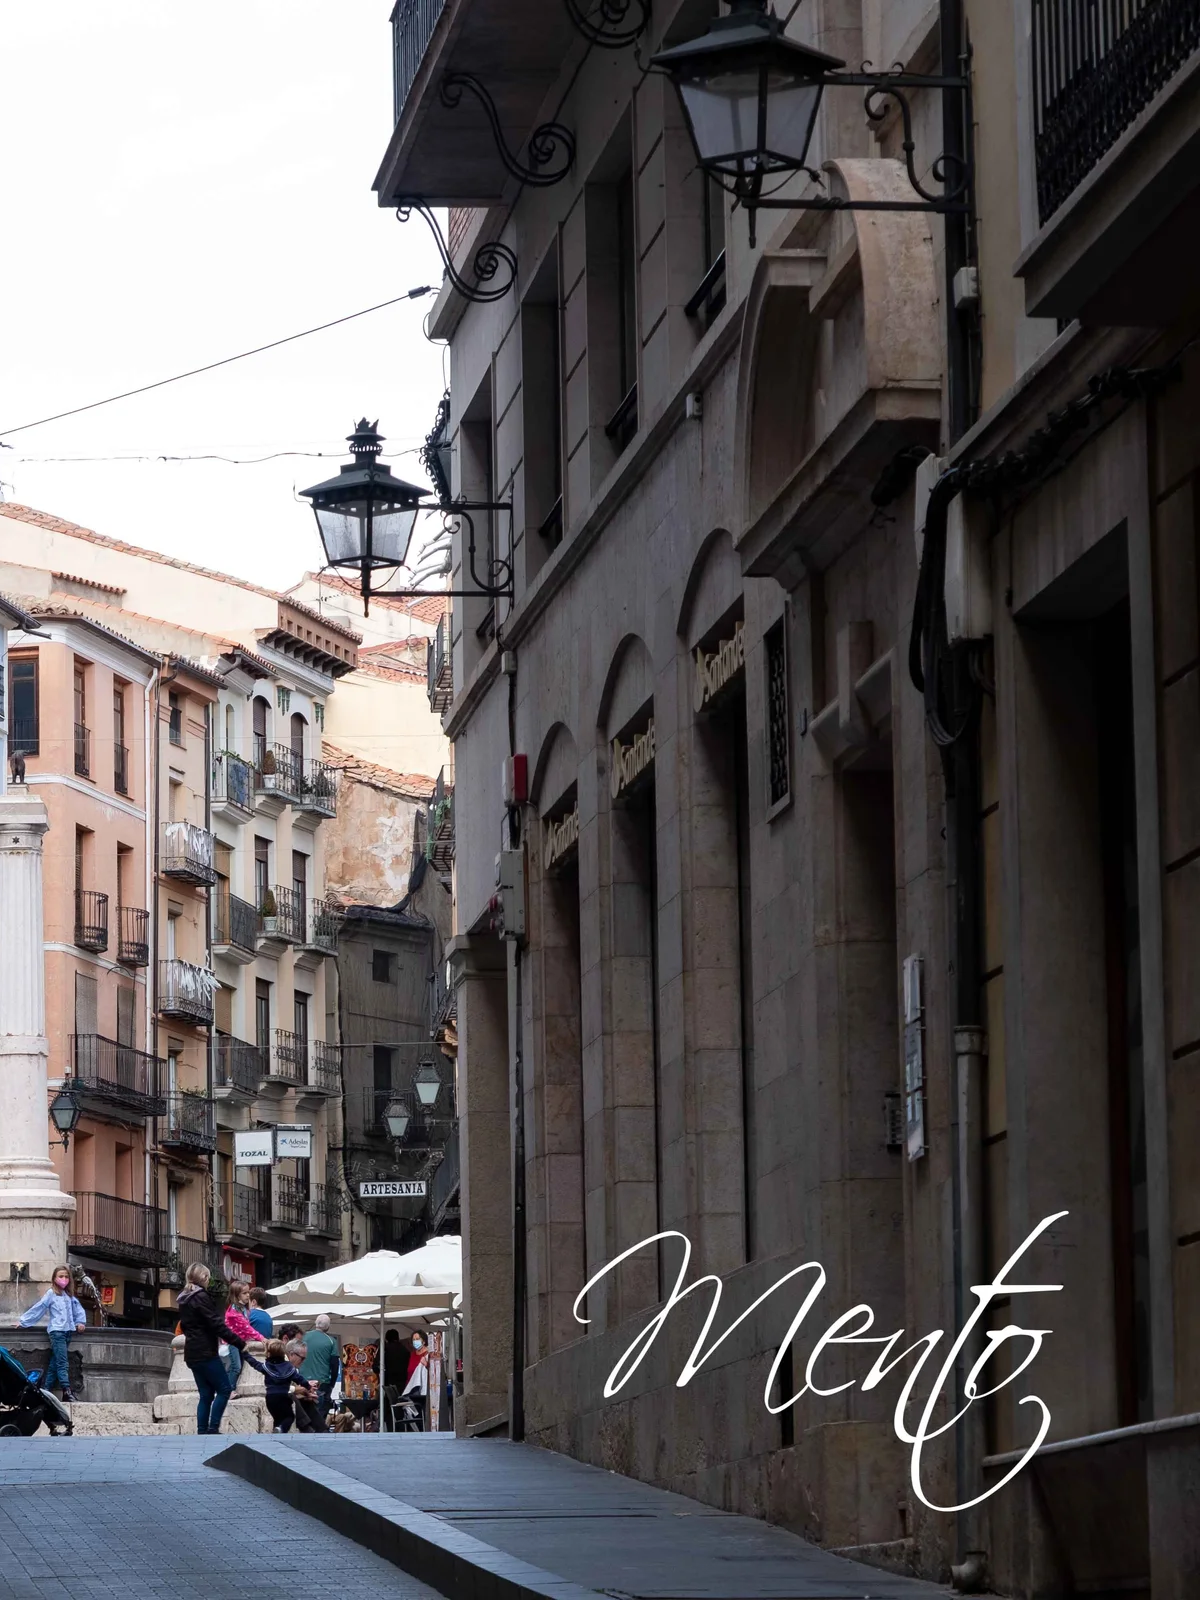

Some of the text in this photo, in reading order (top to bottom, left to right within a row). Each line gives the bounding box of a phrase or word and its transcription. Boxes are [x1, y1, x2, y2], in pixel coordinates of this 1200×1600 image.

[704, 620, 745, 703] Santande
[621, 717, 656, 791] Santande
[239, 1150, 268, 1158] TOZAL
[363, 1183, 424, 1194] ARTESANIA
